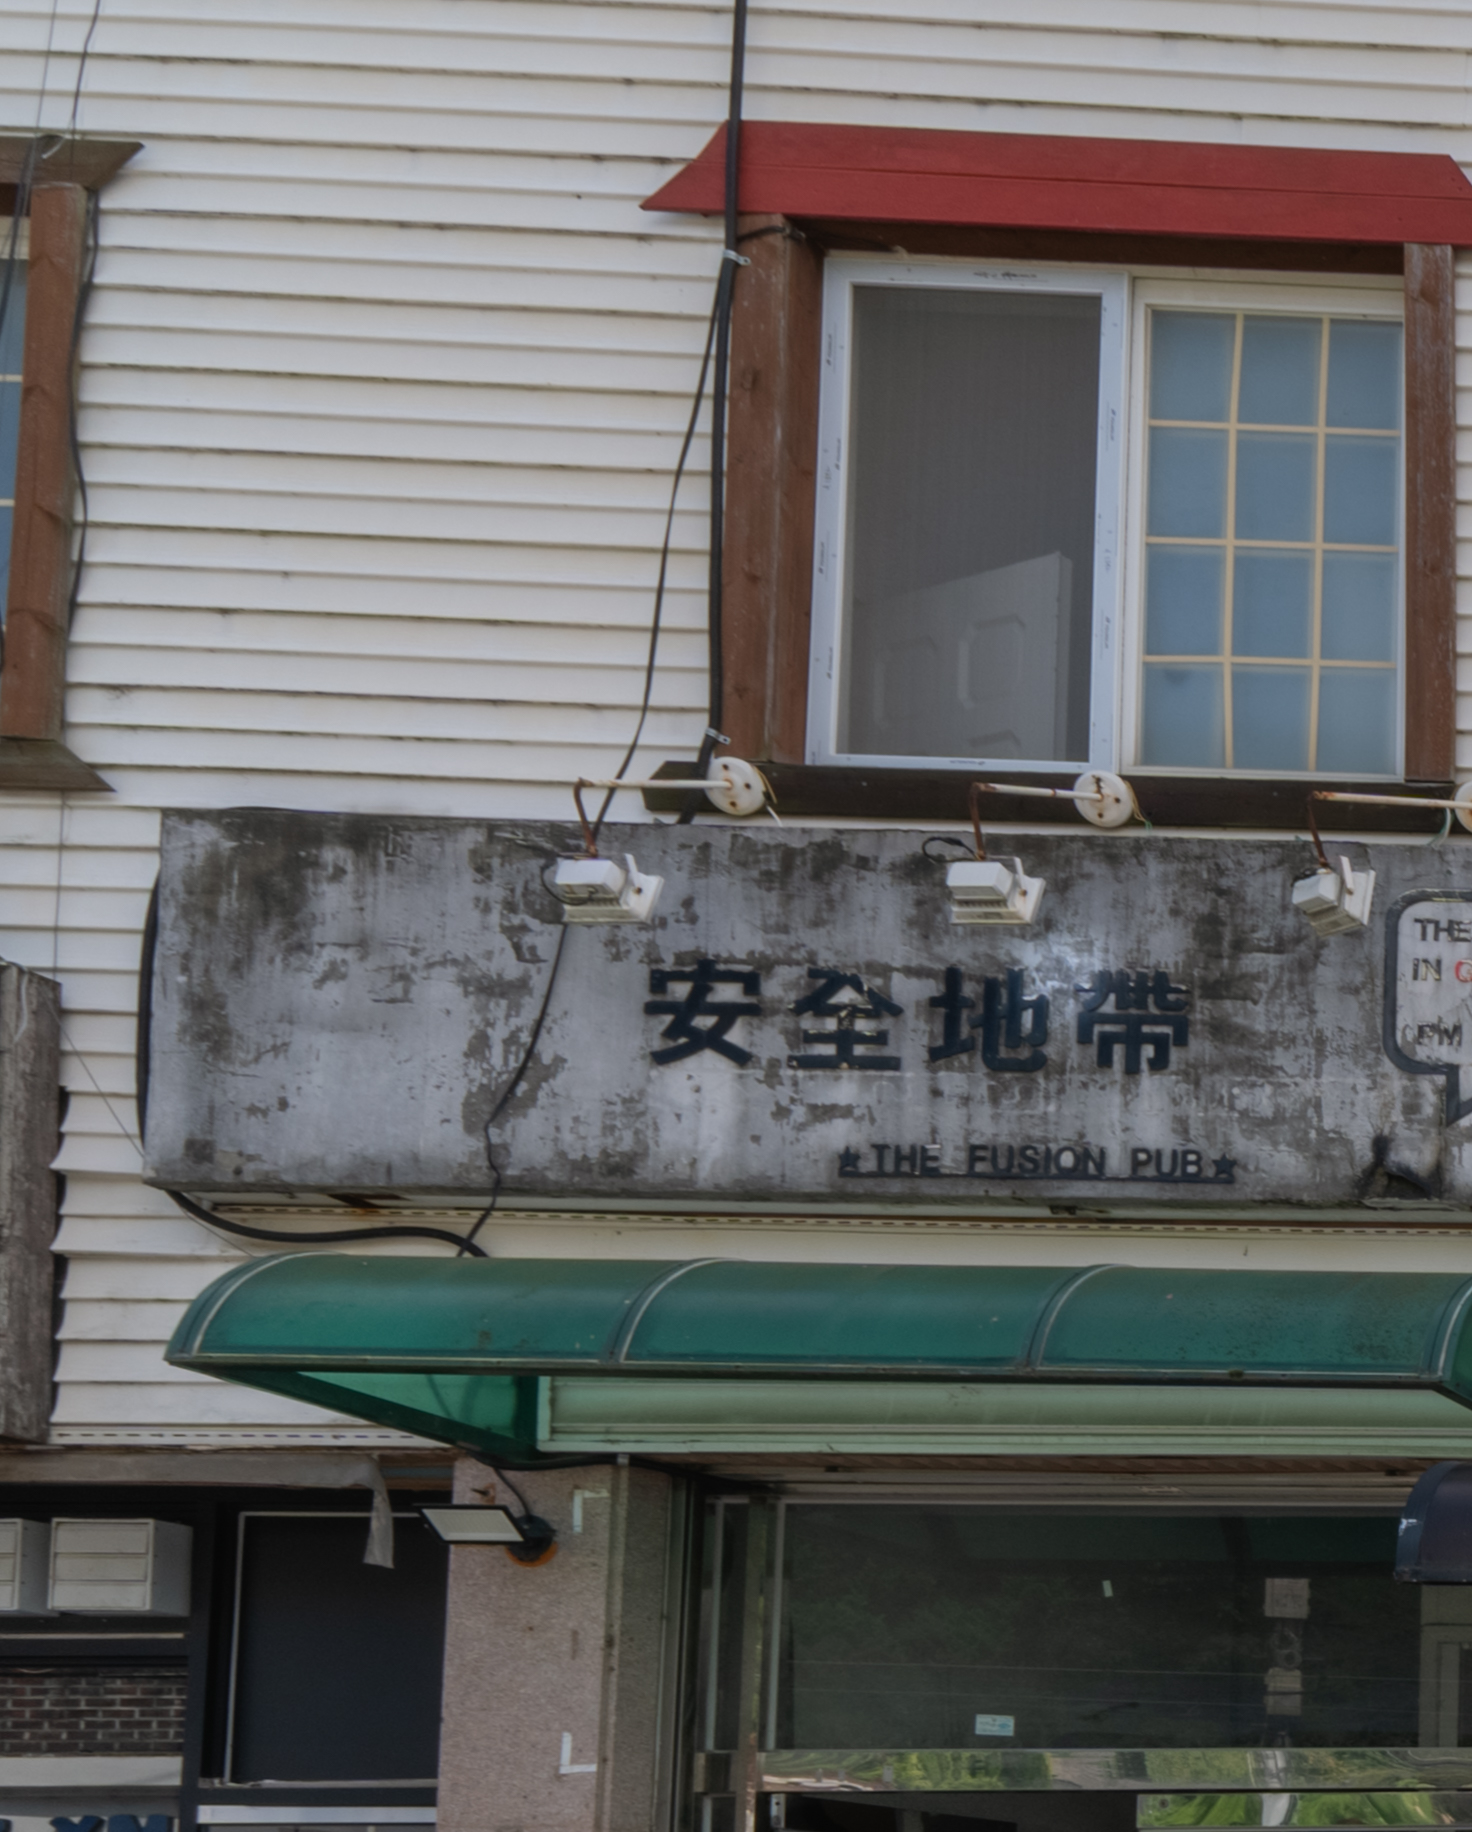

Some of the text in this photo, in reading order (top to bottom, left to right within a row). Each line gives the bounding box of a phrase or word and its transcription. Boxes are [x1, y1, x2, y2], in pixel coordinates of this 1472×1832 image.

[1413, 917, 1472, 943] THE
[1411, 957, 1443, 982] IN
[643, 957, 1191, 1075] 安全地帶
[1416, 1021, 1464, 1047] PM
[871, 1143, 1205, 1178] THE FUSION PUB
